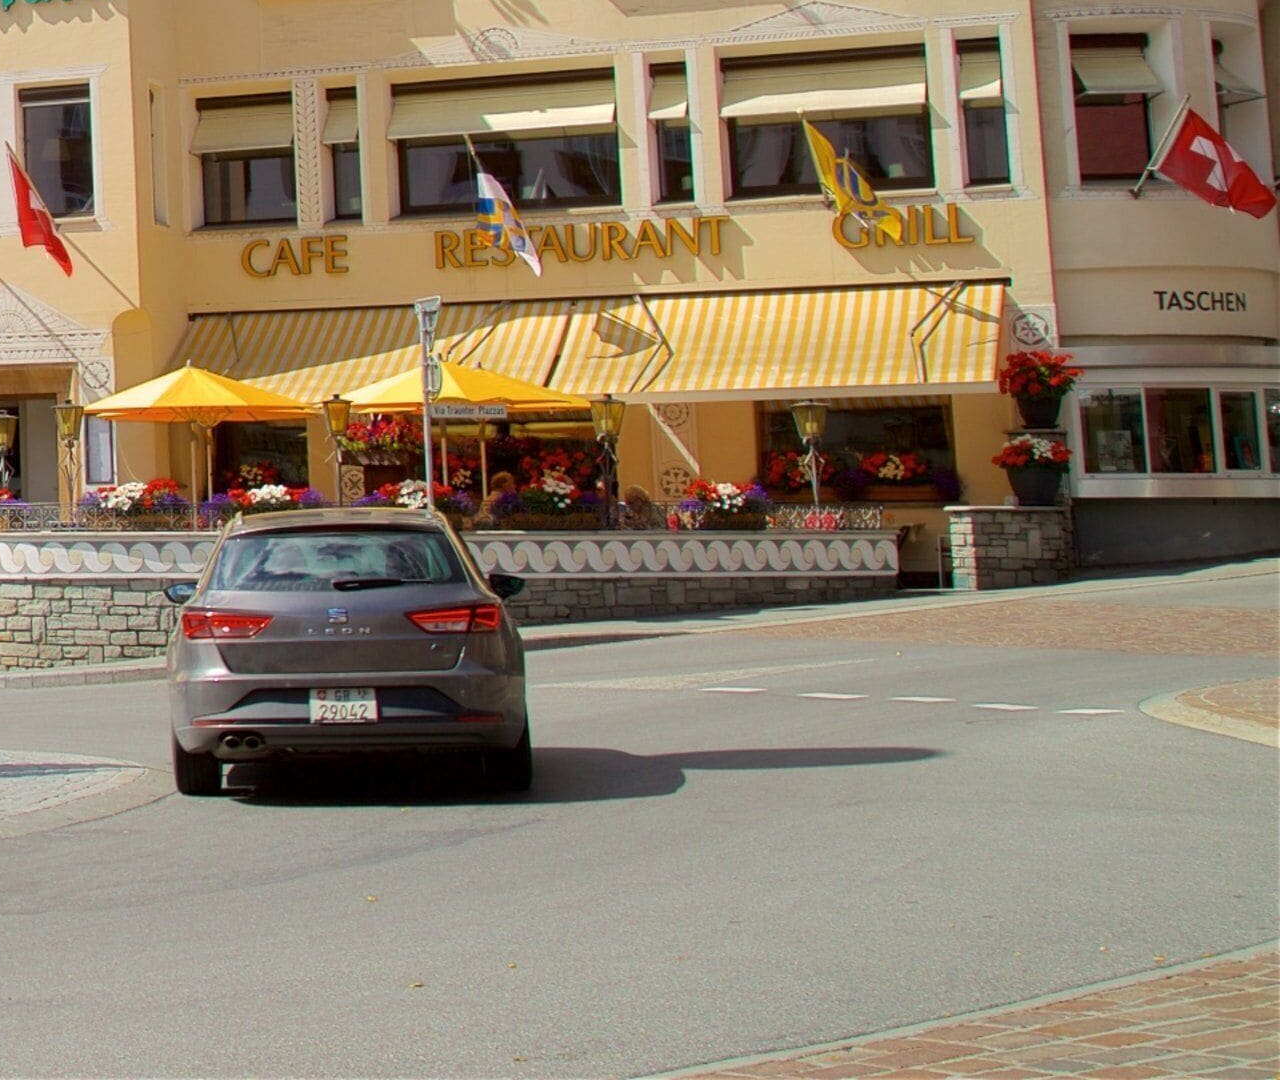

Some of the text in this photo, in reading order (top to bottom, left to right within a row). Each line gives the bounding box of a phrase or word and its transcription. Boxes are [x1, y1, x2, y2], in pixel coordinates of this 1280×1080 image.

[240, 234, 349, 278] CAFE
[1152, 290, 1248, 312] TASCHEN
[319, 703, 368, 721] 29042
